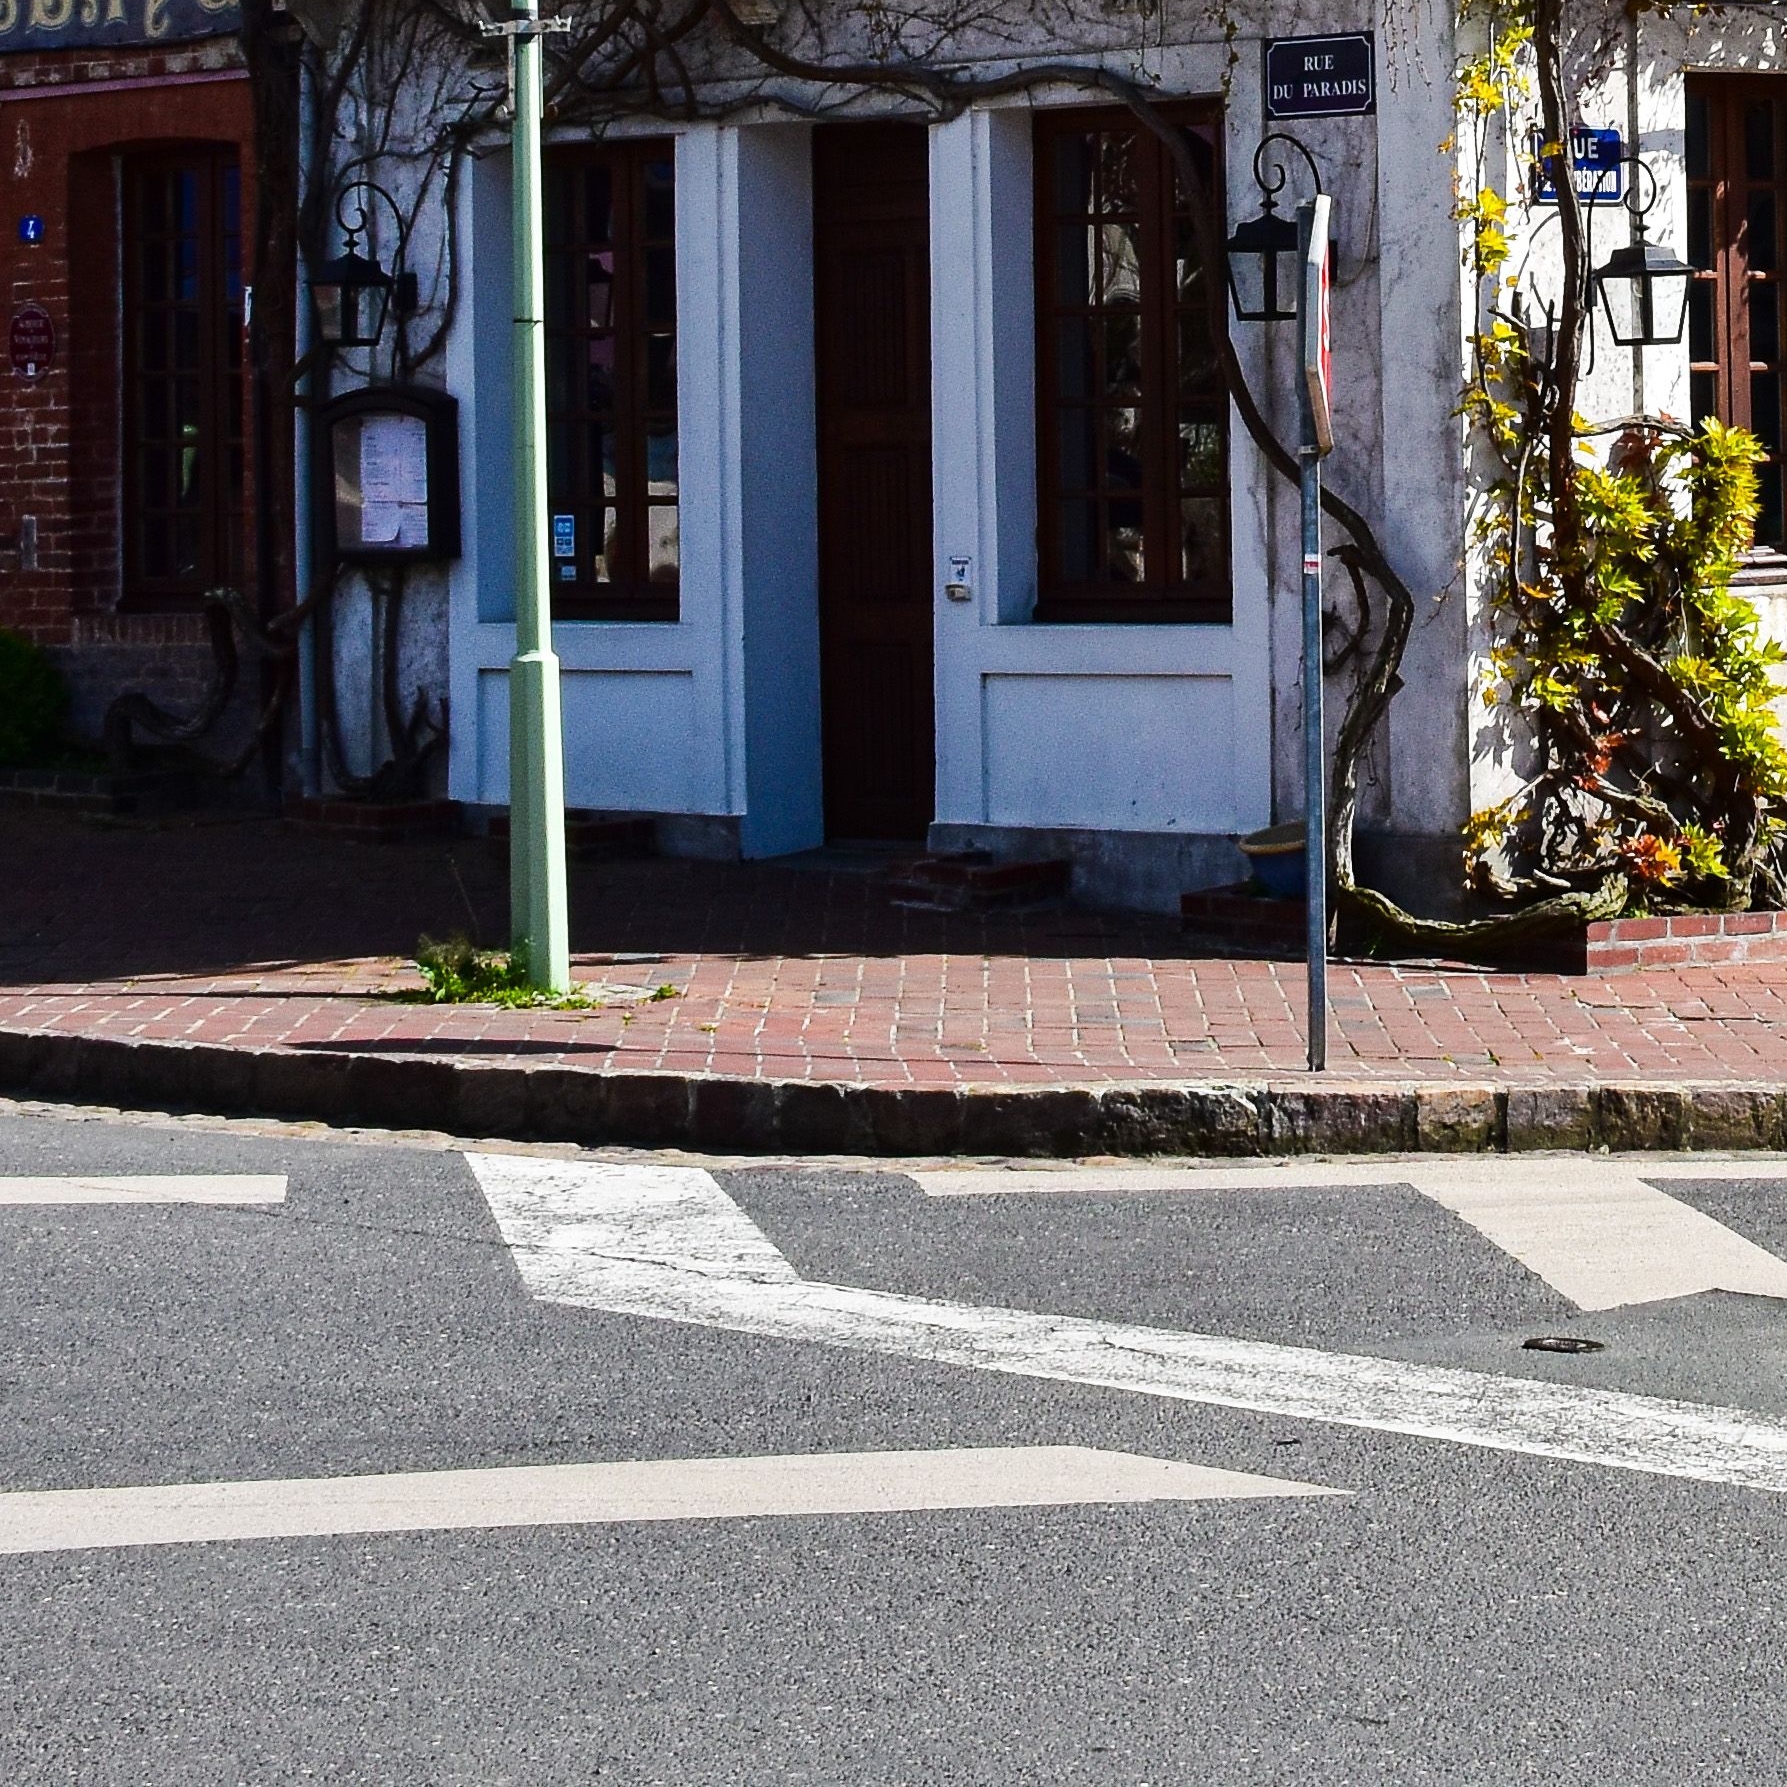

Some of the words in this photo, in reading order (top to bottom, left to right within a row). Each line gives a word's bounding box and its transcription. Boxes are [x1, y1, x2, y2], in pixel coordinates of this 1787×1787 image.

[1304, 54, 1334, 71] RUE
[1273, 84, 1293, 100] DU
[1303, 78, 1367, 98] PARADIS
[1573, 137, 1599, 159] UE
[27, 220, 36, 239] 4
